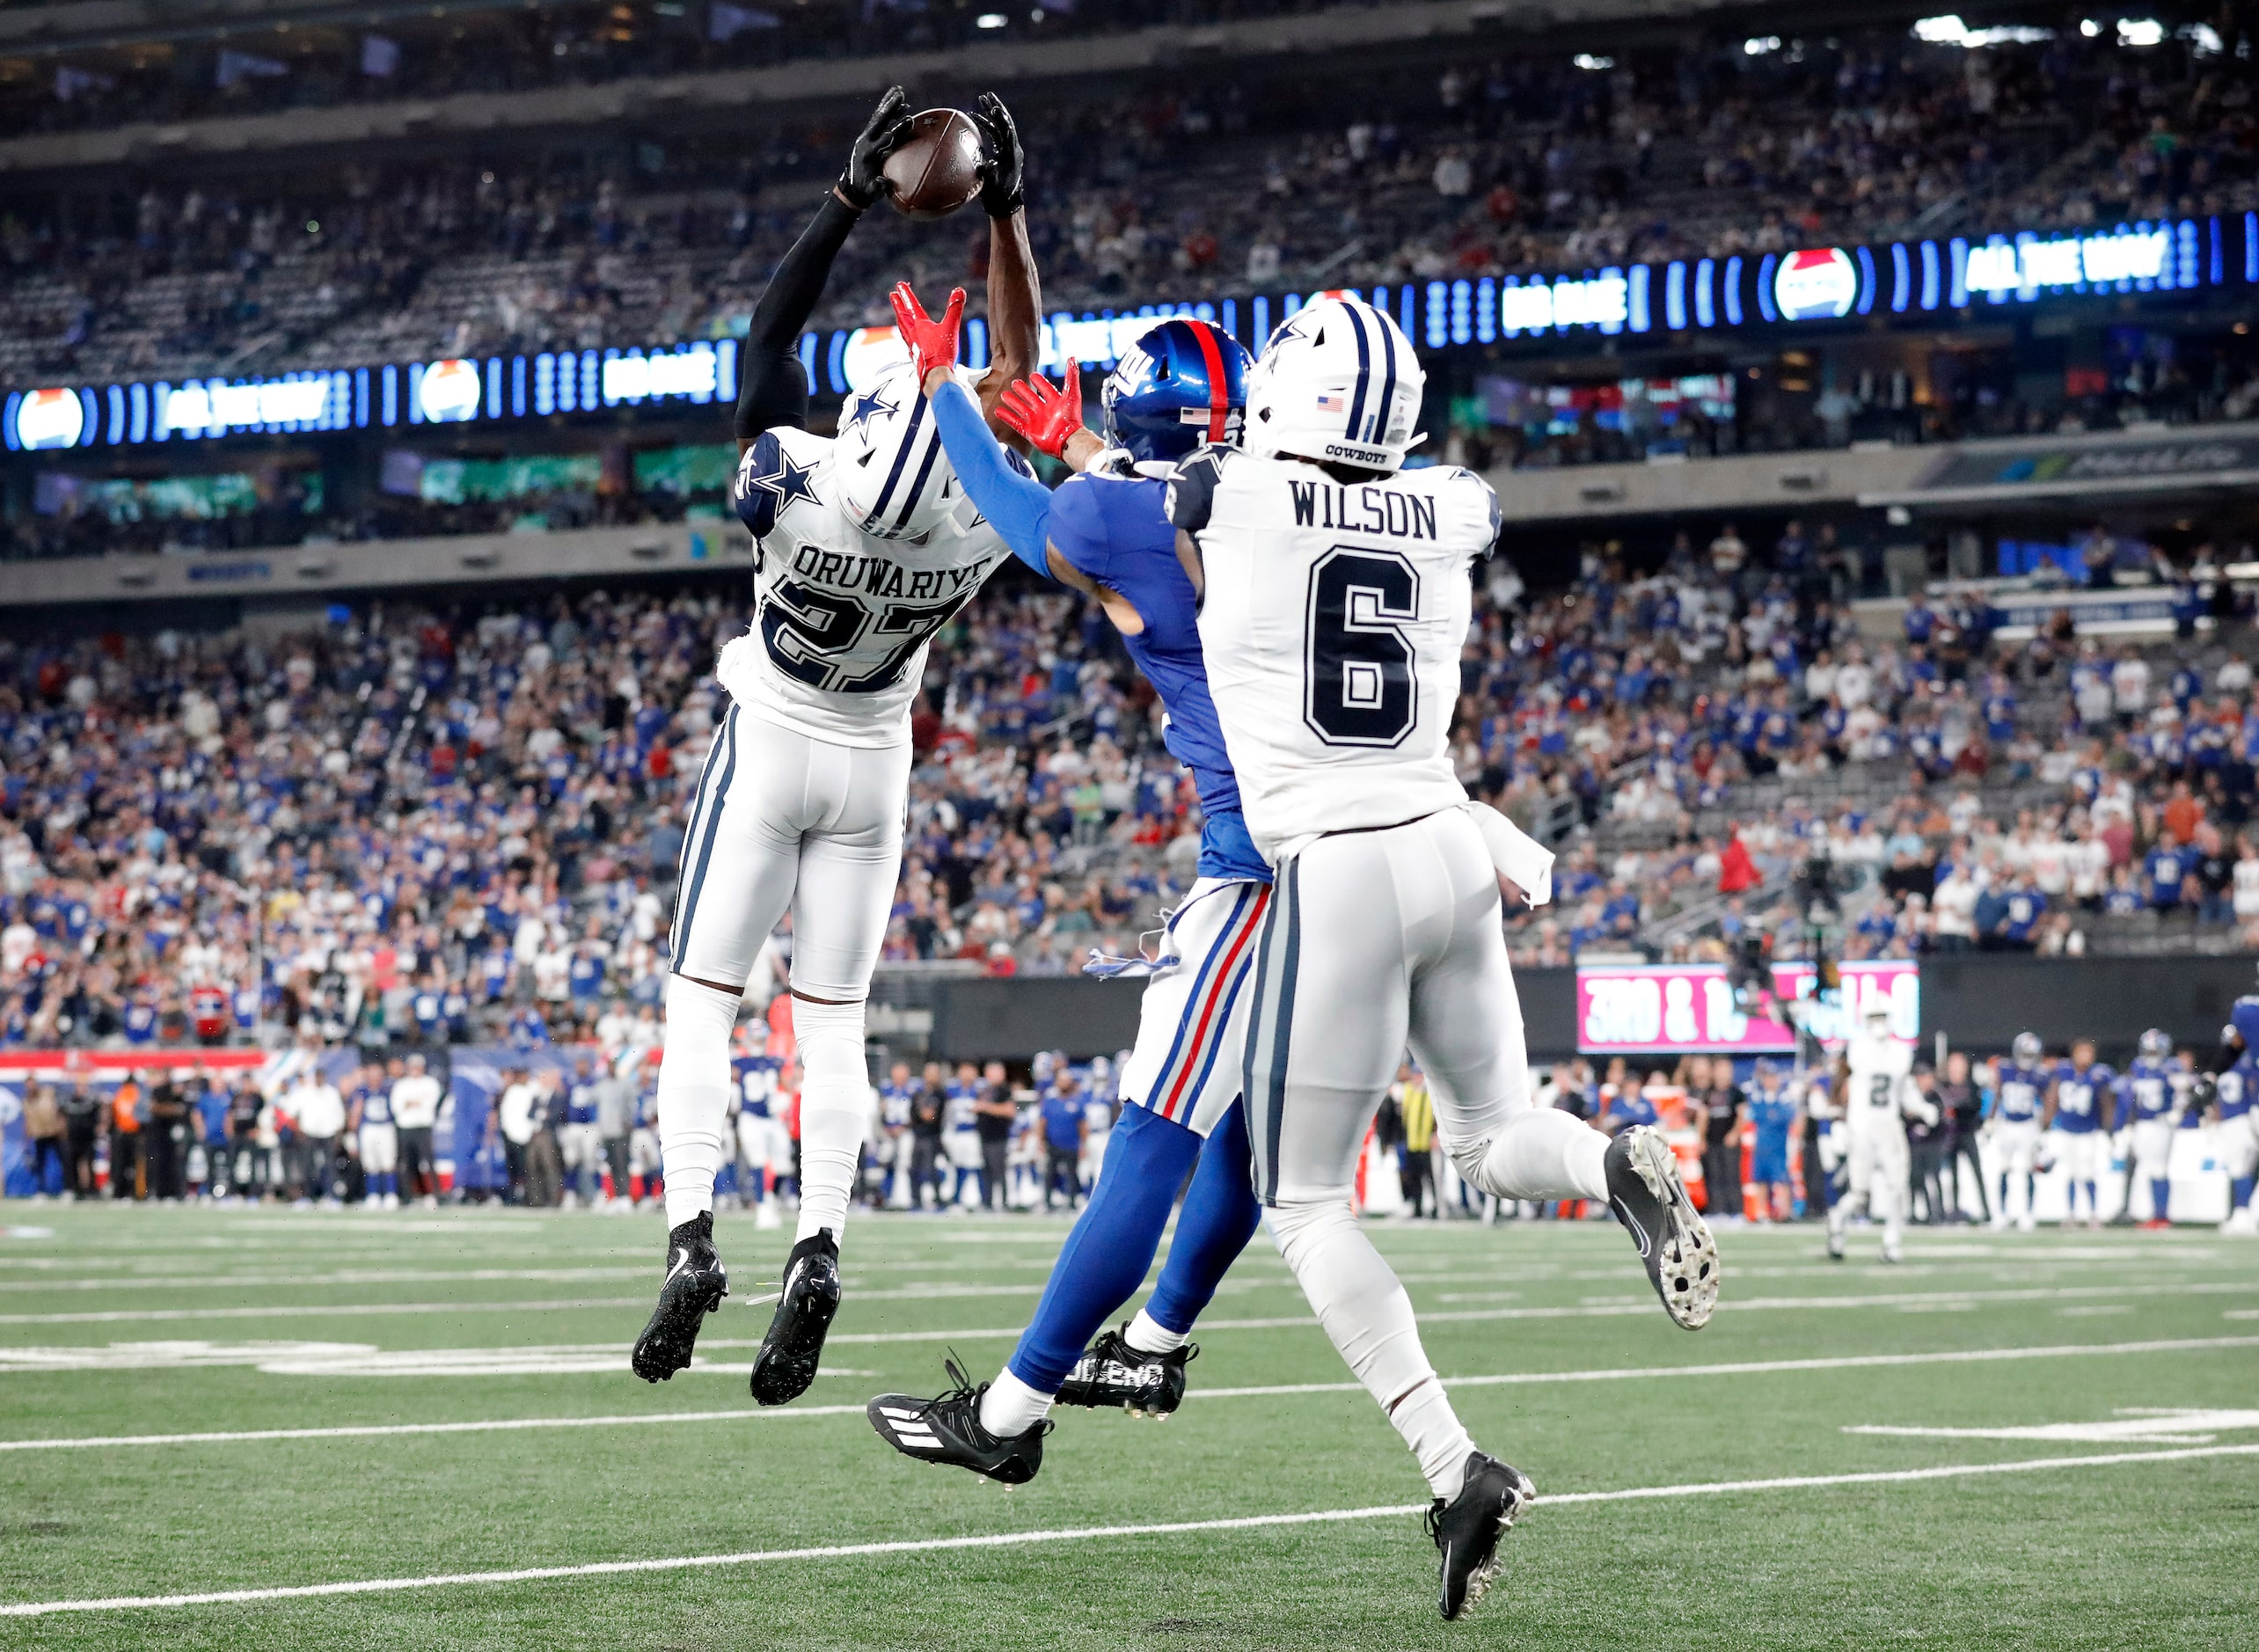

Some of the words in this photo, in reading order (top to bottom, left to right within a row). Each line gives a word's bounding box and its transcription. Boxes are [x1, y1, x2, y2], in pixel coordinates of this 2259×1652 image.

[1326, 444, 1387, 464] COWBOYS
[1288, 480, 1437, 540] WILSON
[760, 574, 973, 693] 27
[1304, 545, 1420, 749] 6
[1584, 977, 1661, 1042] 3RD
[1665, 977, 1699, 1042] &
[1870, 1072, 1893, 1108] 2
